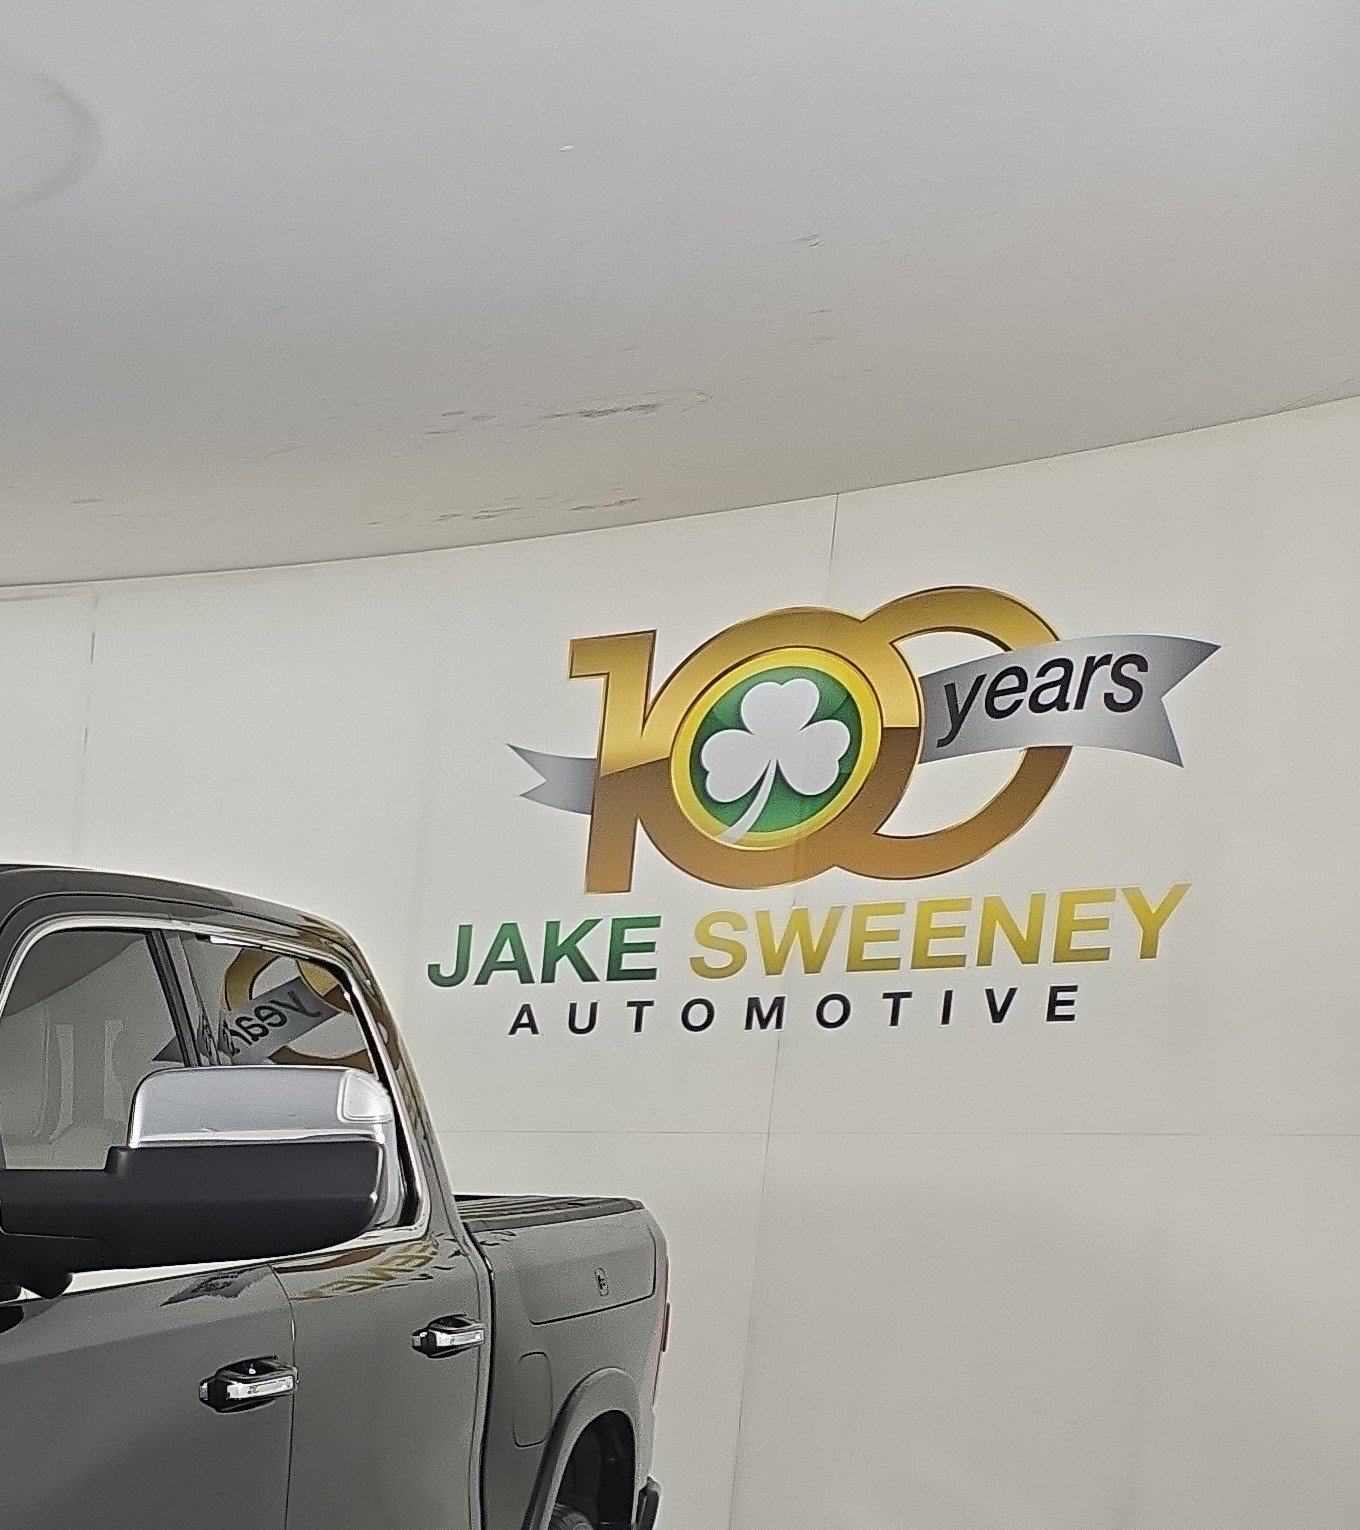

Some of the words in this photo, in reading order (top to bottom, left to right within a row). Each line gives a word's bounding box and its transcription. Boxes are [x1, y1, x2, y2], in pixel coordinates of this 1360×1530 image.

[935, 652, 1149, 747] years
[427, 914, 663, 989] JAKE
[688, 883, 1194, 980] SWEENEY
[508, 984, 1080, 1037] AUTOMOTIVE
